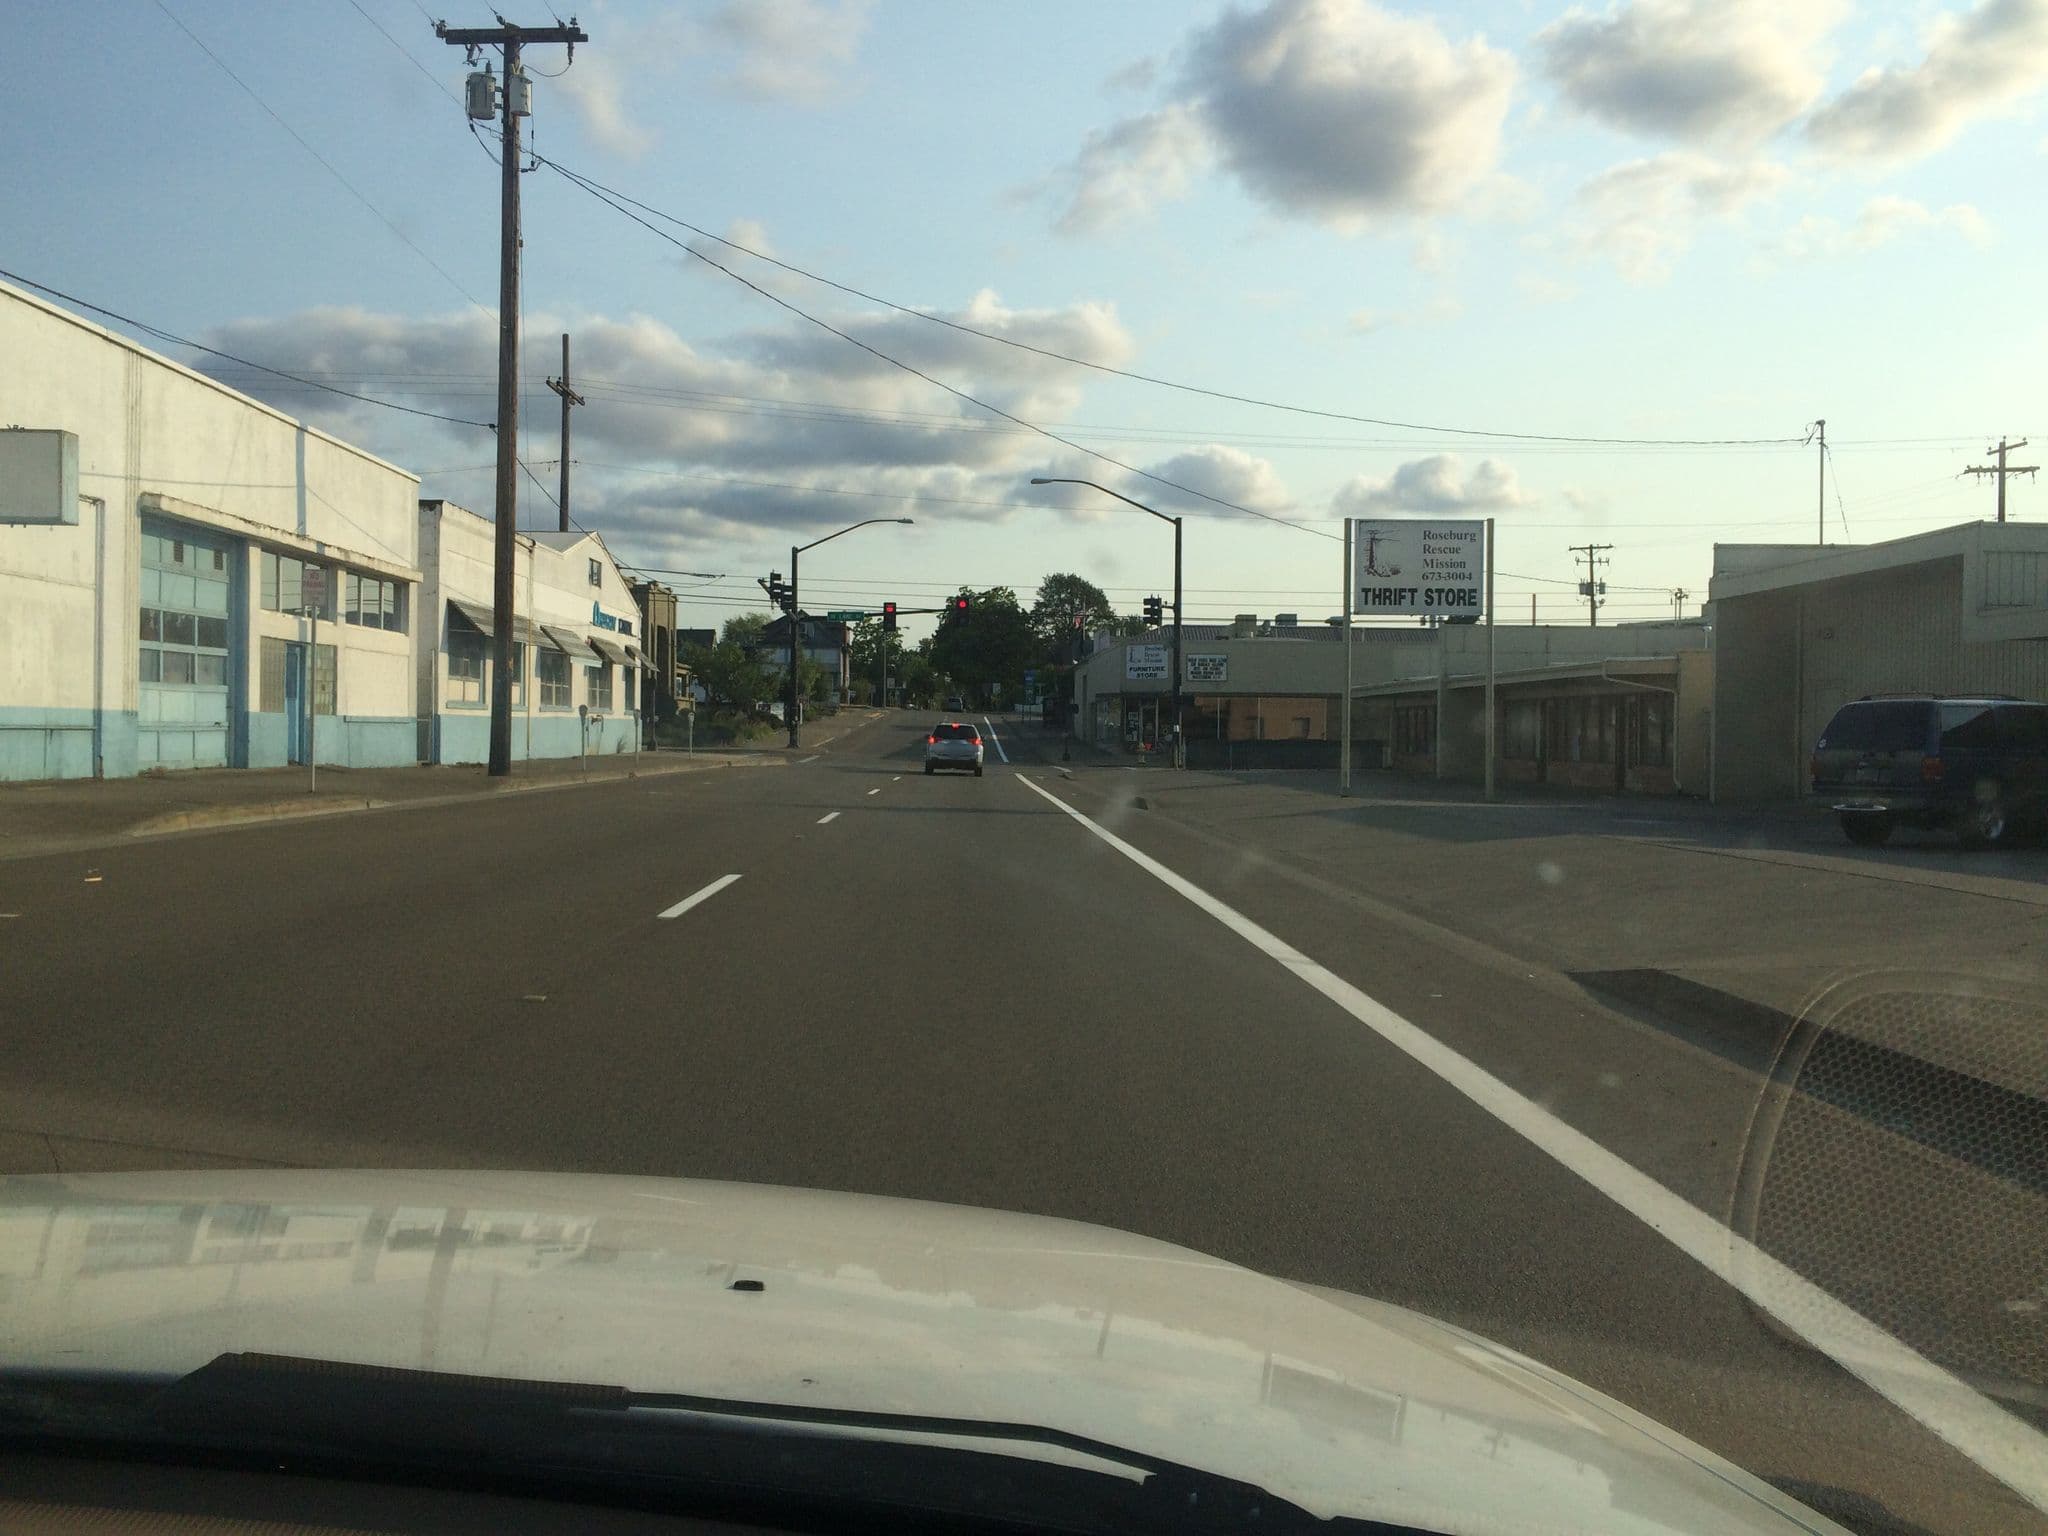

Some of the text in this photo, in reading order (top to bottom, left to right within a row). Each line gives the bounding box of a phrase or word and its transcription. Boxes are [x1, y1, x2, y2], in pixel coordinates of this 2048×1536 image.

[1423, 530, 1476, 542] Roseburg
[1423, 544, 1461, 554] Rescue
[1423, 558, 1466, 569] Mission
[1421, 571, 1473, 581] 673-3004
[1361, 587, 1478, 607] THRIFT STORE
